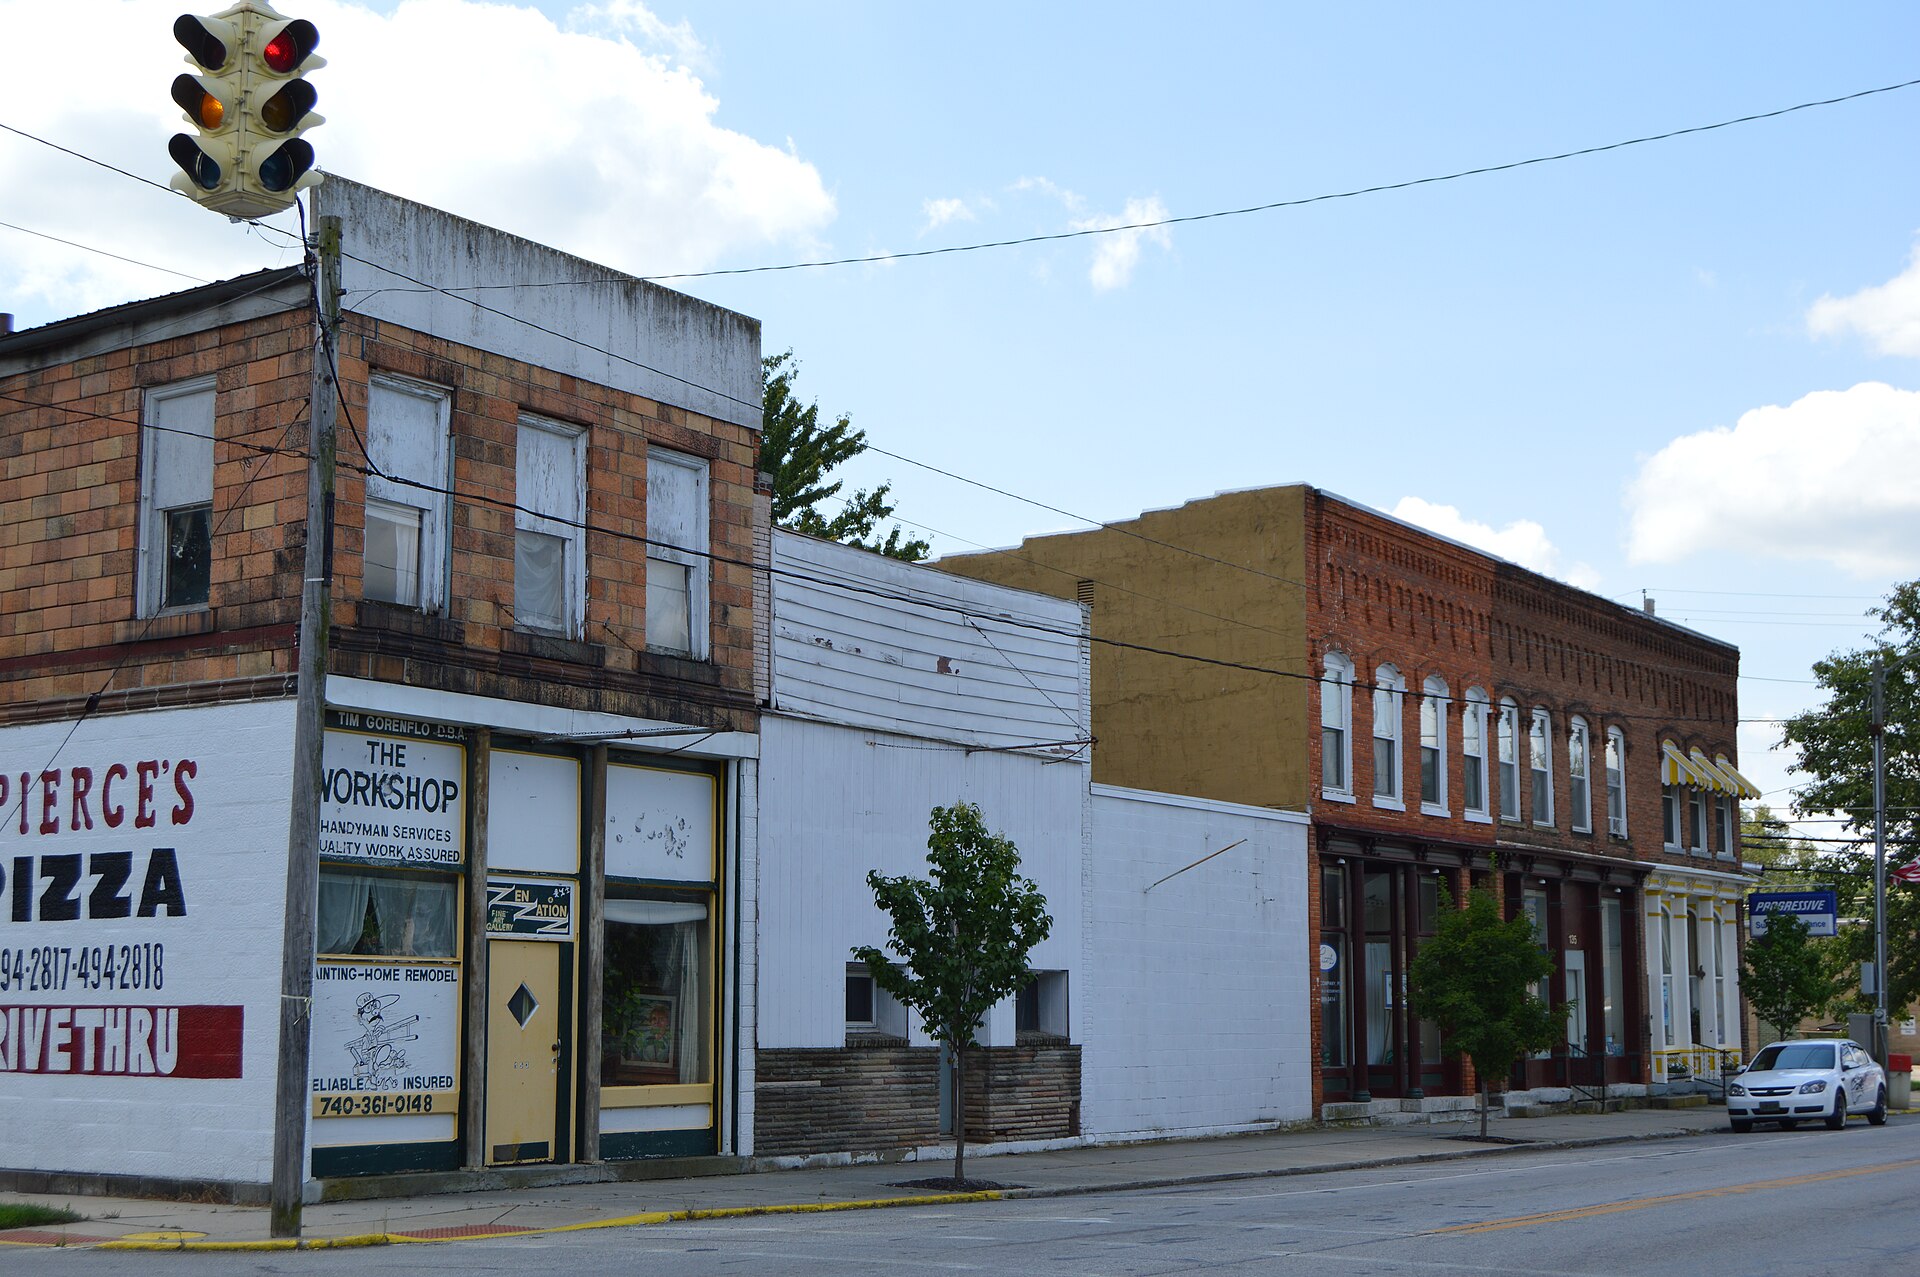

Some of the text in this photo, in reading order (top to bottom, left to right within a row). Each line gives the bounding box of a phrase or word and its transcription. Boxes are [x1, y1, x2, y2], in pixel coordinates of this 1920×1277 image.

[338, 711, 360, 727] TIM
[366, 716, 430, 736] GORENFLO
[366, 740, 407, 768] THE
[320, 819, 451, 842] HANDYMAN SERVICES
[319, 838, 460, 863] UALITY WORK ASSURED
[0, 848, 187, 922] IZZA
[491, 910, 507, 918] FINE
[493, 916, 505, 924] ART
[486, 922, 514, 931] GALLERY
[315, 967, 458, 982] INTING-HOME REMODEL
[312, 1075, 453, 1092] ELIABLE INSURED
[320, 1094, 433, 1115] 740-361-0148
